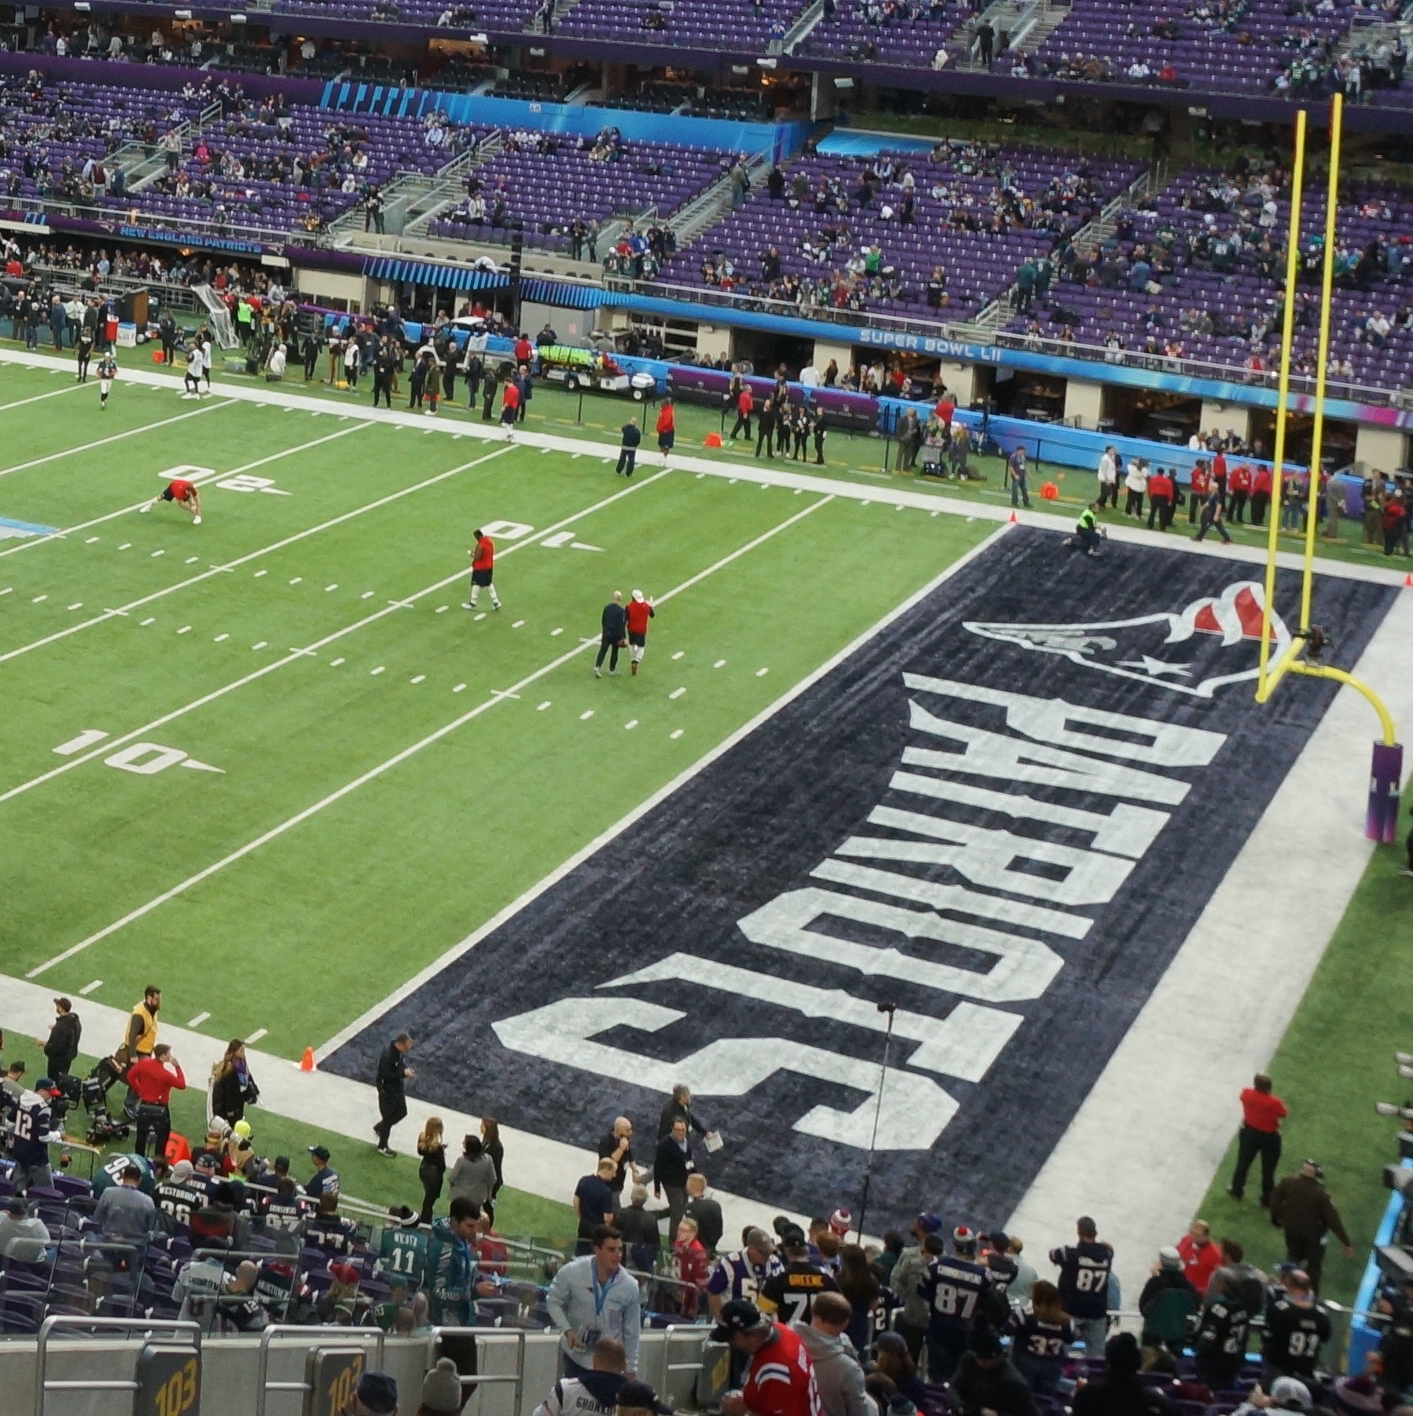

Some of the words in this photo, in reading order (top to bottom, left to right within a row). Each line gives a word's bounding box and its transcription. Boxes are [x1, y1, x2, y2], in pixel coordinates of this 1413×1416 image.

[120, 227, 146, 238] NEW
[148, 229, 203, 247] ENGLAND
[204, 237, 262, 253] PATRIOTS
[860, 329, 916, 349] SUPER
[926, 339, 973, 359] BOWL
[981, 346, 1002, 363] LII
[52, 728, 188, 774] 10
[491, 671, 1226, 1151] PATRIOTS
[14, 1109, 33, 1140] 12
[393, 1232, 418, 1247] WENTZ
[391, 1247, 415, 1273] 11
[1076, 1268, 1107, 1292] 87
[243, 1299, 259, 1313] 12
[934, 1283, 979, 1317] 87
[1288, 1330, 1318, 1358] 91
[155, 1357, 198, 1416] 103
